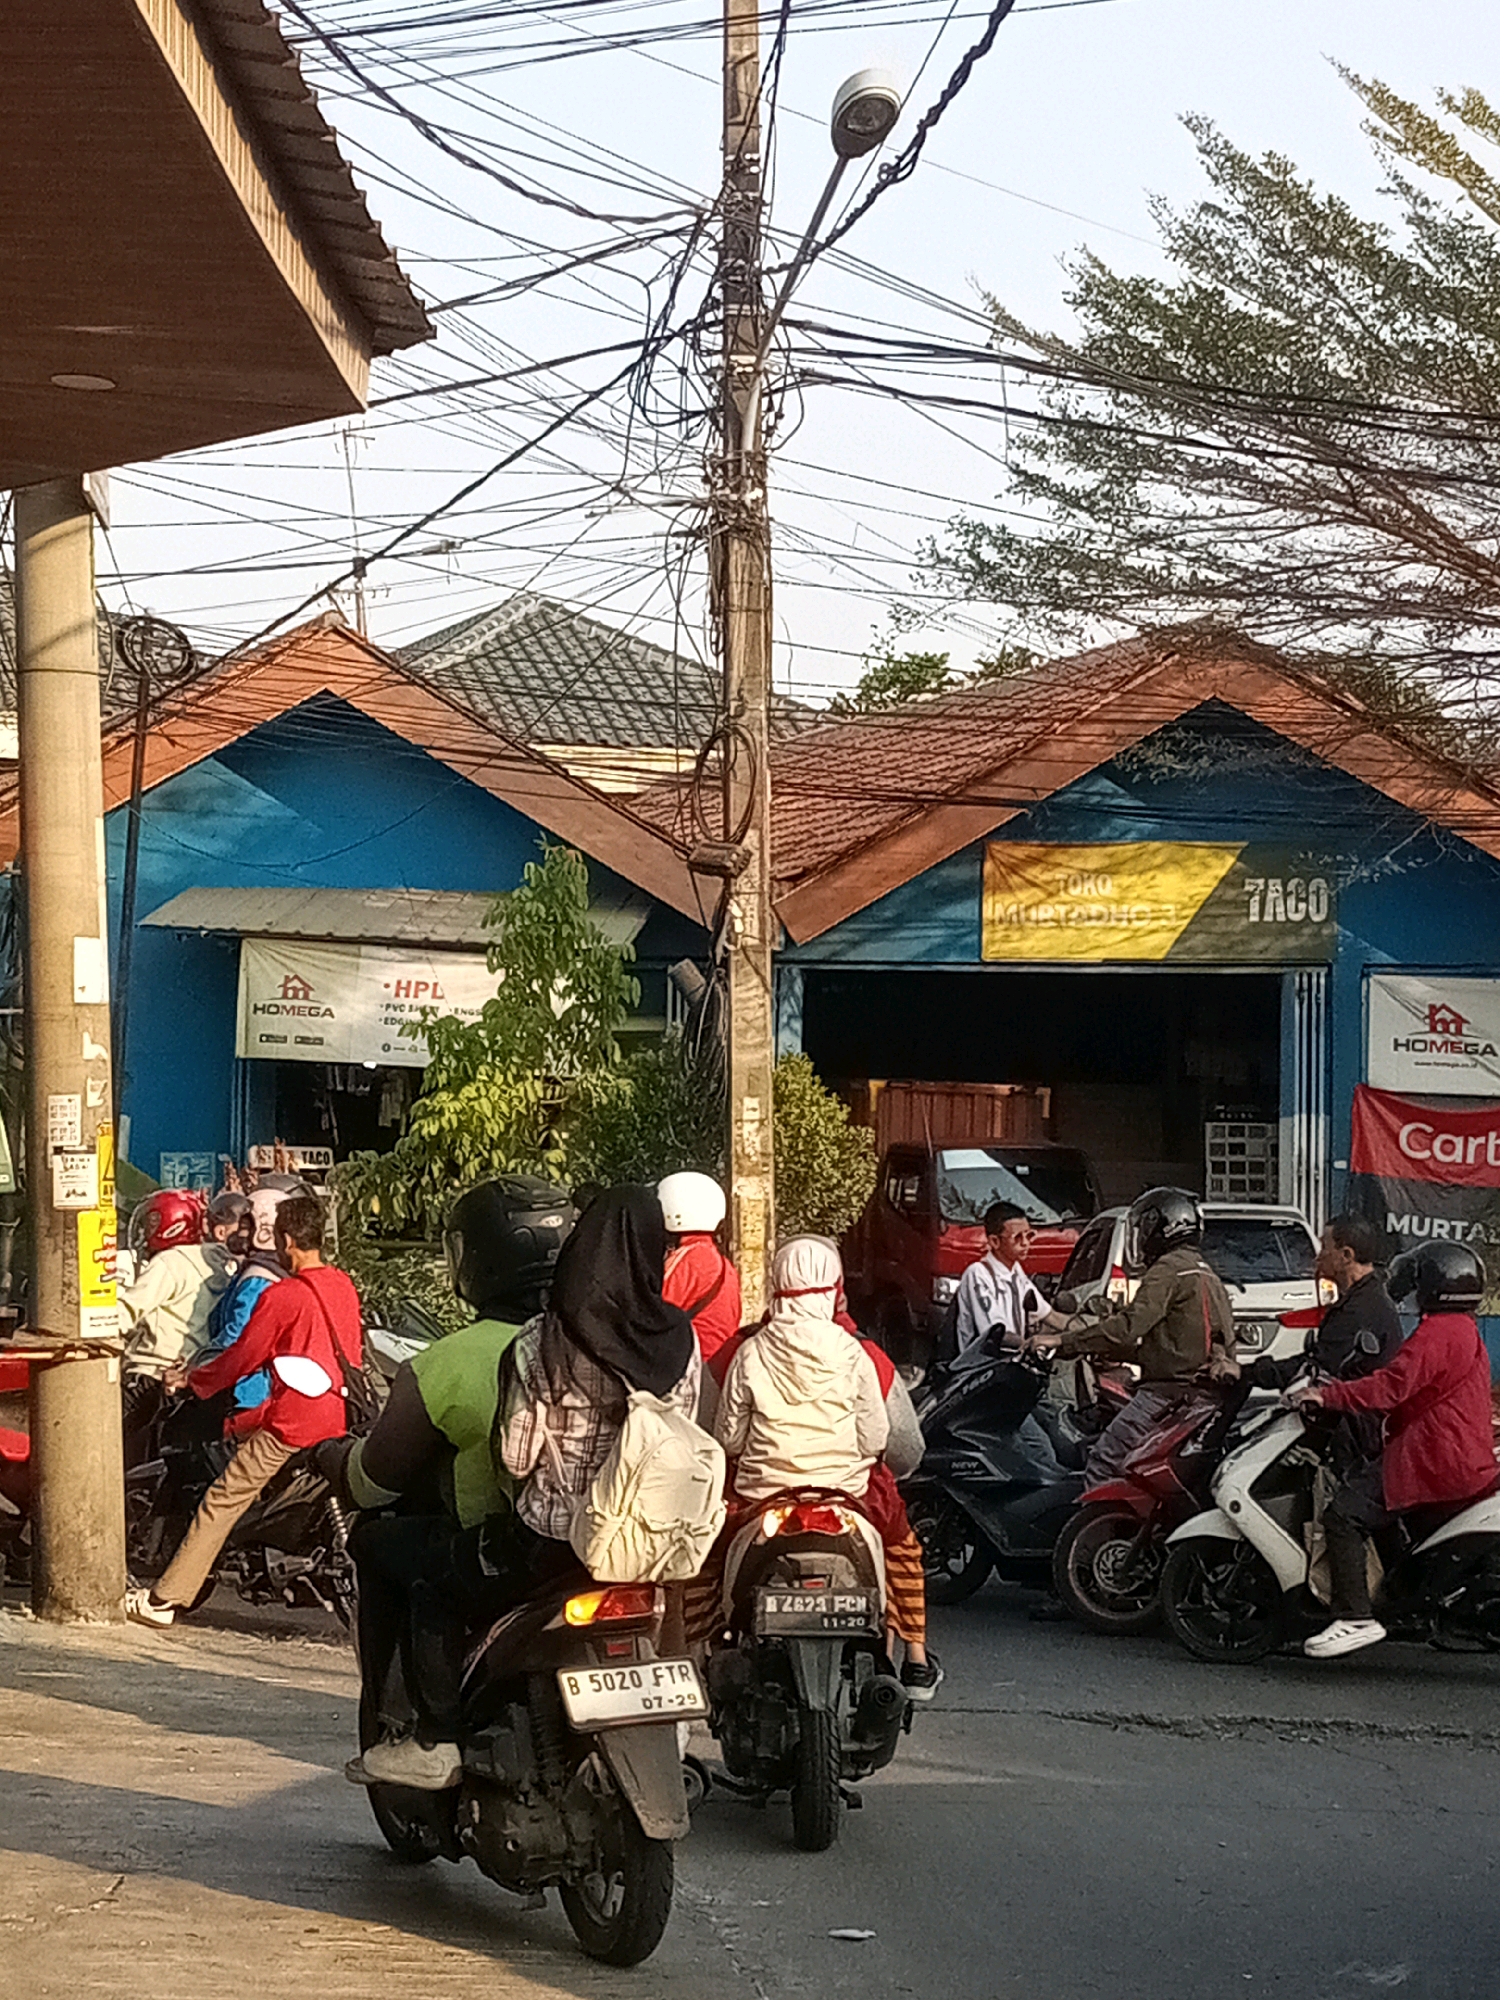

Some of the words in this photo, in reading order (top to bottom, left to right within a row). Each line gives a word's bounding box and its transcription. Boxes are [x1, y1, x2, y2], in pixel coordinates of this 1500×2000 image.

[1054, 873, 1113, 896] TOKO
[1244, 877, 1329, 923] TACO
[394, 979, 446, 1000] HPL
[252, 1003, 335, 1019] HOMEGA
[1393, 1038, 1499, 1057] HOMEGA
[301, 1150, 330, 1166] TACO
[566, 1676, 581, 1696] B
[588, 1670, 643, 1693] 5020
[651, 1664, 692, 1688] FTR
